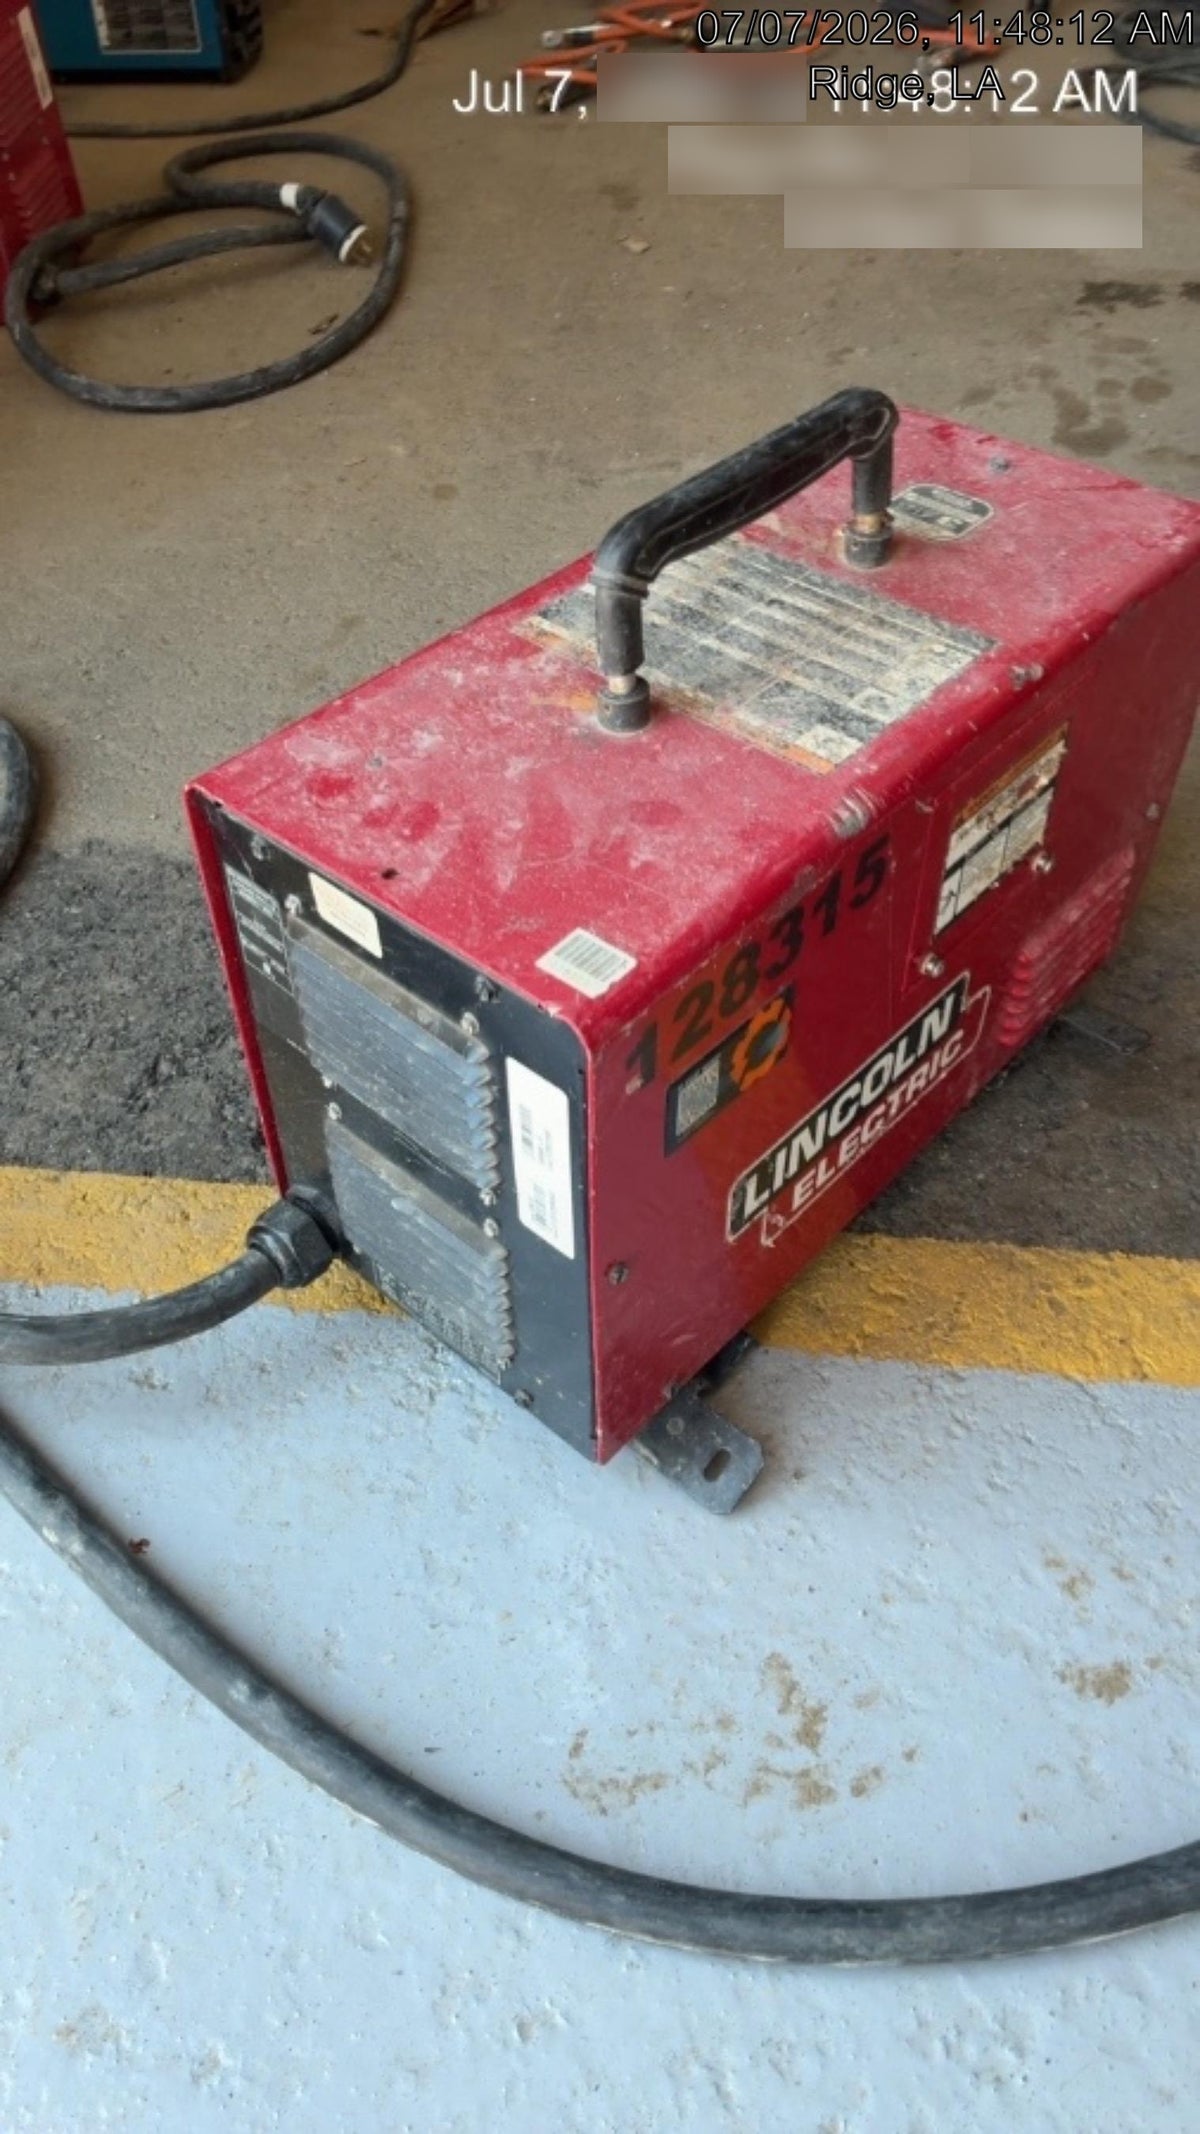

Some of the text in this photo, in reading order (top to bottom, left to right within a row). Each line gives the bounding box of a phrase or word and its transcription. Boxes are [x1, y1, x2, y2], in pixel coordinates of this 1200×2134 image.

[626, 835, 890, 1085] 128315
[743, 992, 956, 1219] LINCOLN
[792, 1028, 965, 1212] ELECTRIC
